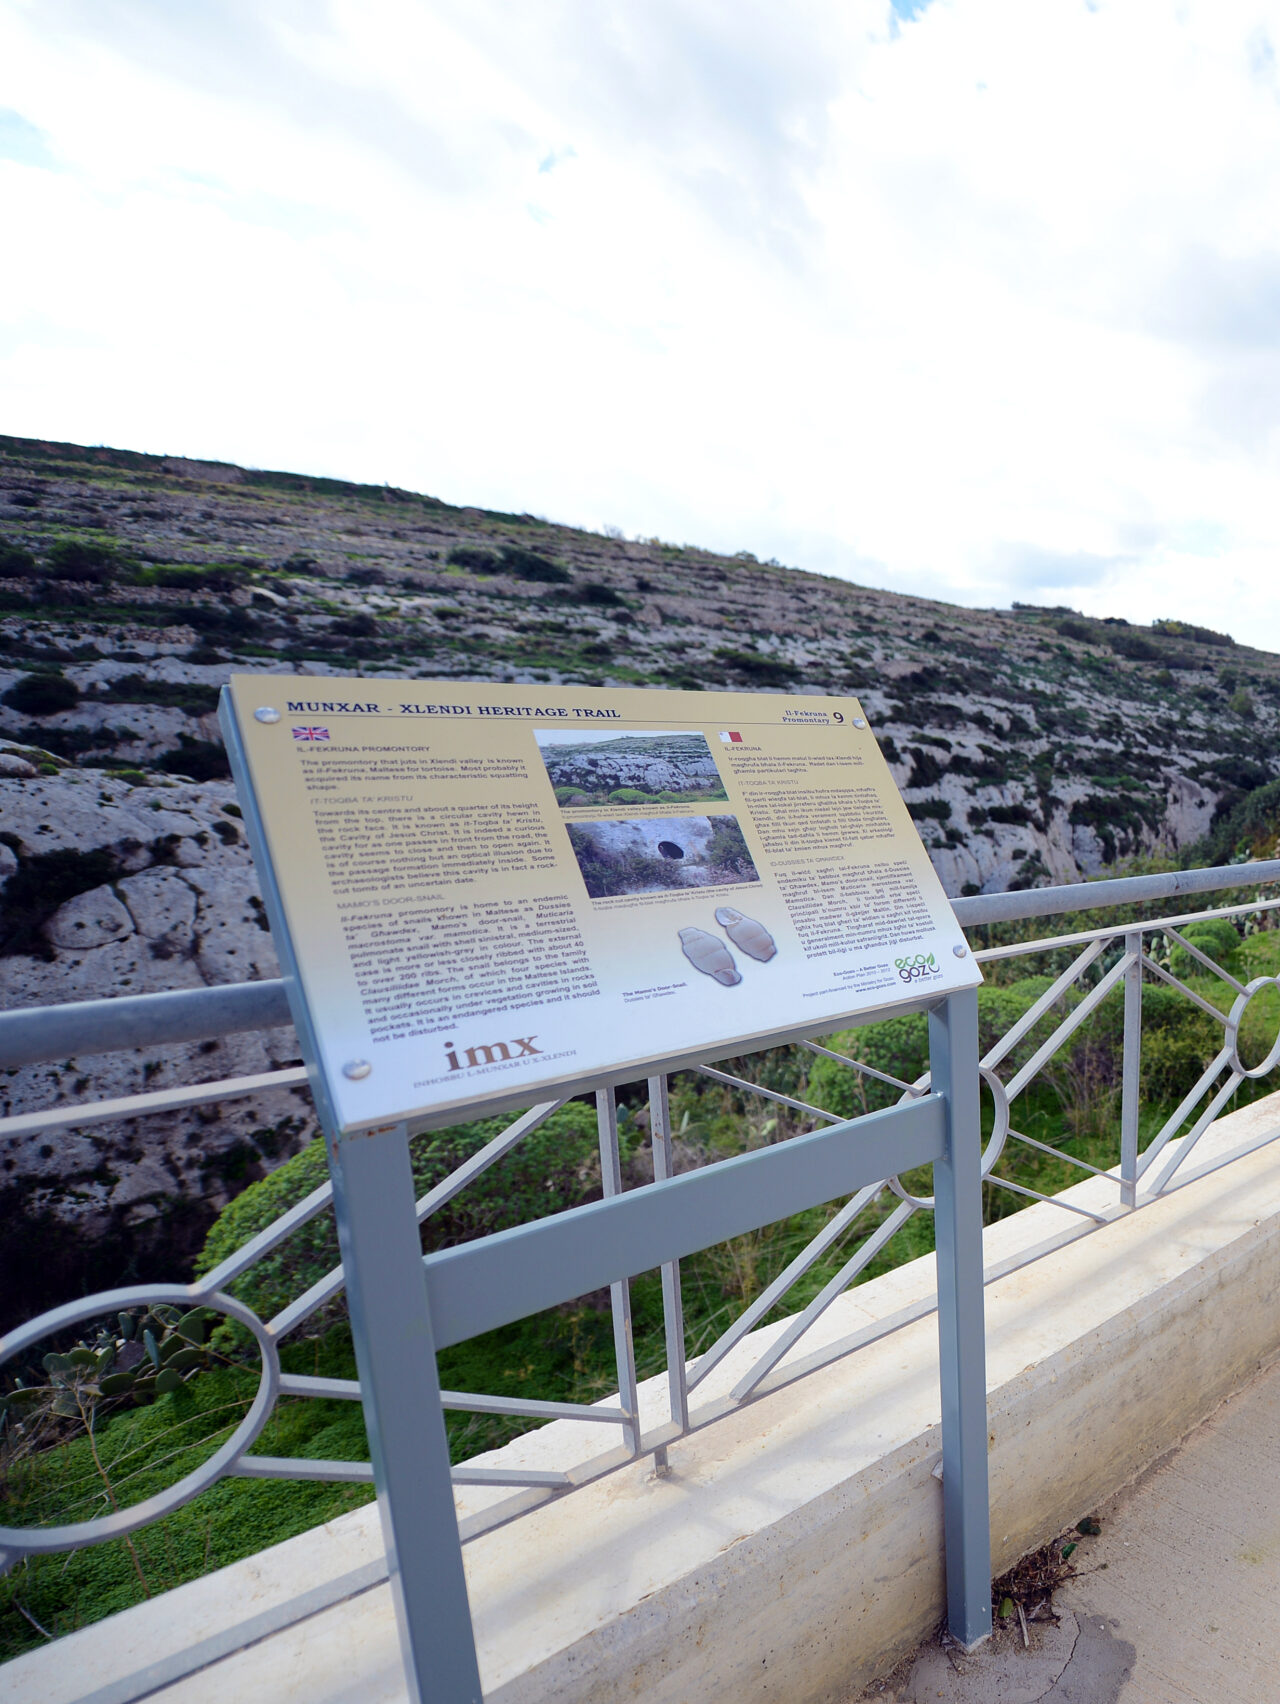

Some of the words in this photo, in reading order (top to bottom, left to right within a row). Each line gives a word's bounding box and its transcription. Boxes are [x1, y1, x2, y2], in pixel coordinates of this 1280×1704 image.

[286, 701, 380, 713] MUNXAR
[399, 704, 472, 715] XLENDI
[477, 706, 568, 717] HERITAGE
[572, 708, 621, 718] TRAIL
[782, 716, 830, 724] Promontary
[833, 712, 844, 723] 9
[333, 887, 351, 895] cut
[351, 885, 379, 893] tomb
[407, 879, 453, 888] uncertain
[350, 948, 405, 961] pulmonate
[406, 943, 431, 952] snail
[431, 941, 453, 949] with
[454, 938, 477, 946] shell
[352, 960, 374, 969] and
[377, 956, 402, 966] light
[405, 948, 476, 963] yellowish-grey
[547, 932, 582, 942] external
[355, 970, 380, 978] case
[395, 964, 422, 972] more
[460, 954, 494, 963] closely
[495, 949, 525, 958] ribbed
[526, 946, 546, 954] with
[547, 942, 572, 951] about
[894, 954, 926, 969] eco
[372, 977, 396, 985] over
[399, 973, 418, 981] 200
[447, 966, 465, 974] The
[467, 962, 491, 971] snail
[493, 957, 530, 967] belongs
[560, 949, 588, 957] family
[478, 968, 507, 978] which
[534, 960, 568, 970] species
[571, 956, 590, 964] with
[362, 997, 392, 1006] many
[393, 988, 437, 1001] different
[437, 985, 467, 994] forms
[468, 980, 496, 989] occur
[524, 970, 558, 980] Maltese
[375, 1003, 413, 1014] usually
[415, 997, 450, 1007] occurs
[464, 988, 504, 999] crevices
[505, 984, 524, 992] and
[525, 979, 559, 989] cavities
[571, 973, 595, 981] rocks
[367, 1015, 389, 1025] and
[390, 1005, 454, 1021] occasionally
[455, 1001, 484, 1010] under
[485, 992, 534, 1005] vegetation
[534, 986, 571, 997] growing
[582, 980, 598, 988] soil
[451, 1004, 509, 1020] endangered
[509, 999, 545, 1010] species
[545, 995, 563, 1003] and
[571, 988, 601, 999] should
[372, 1034, 391, 1043] not
[444, 1035, 544, 1072] imx
